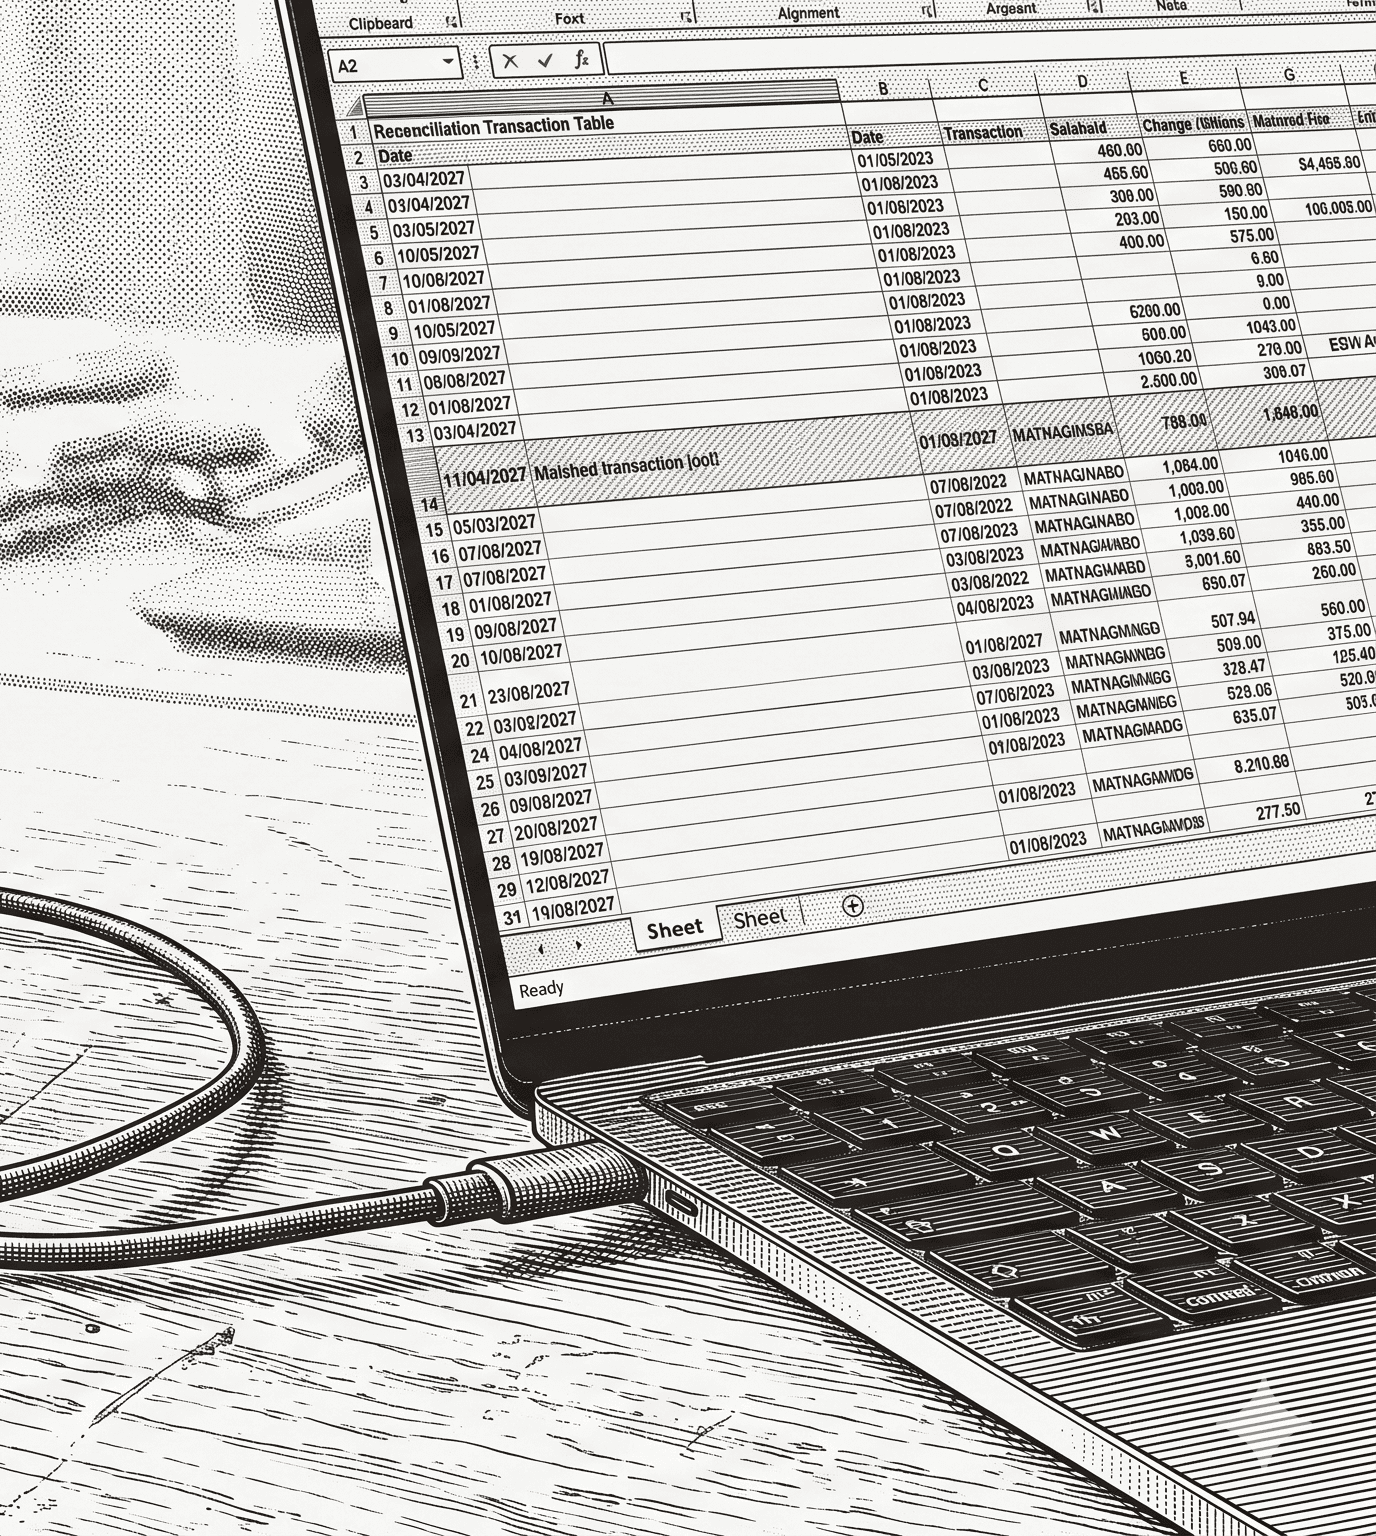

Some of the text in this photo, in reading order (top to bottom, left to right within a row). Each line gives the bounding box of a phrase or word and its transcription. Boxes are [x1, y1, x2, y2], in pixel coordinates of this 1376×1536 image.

[339, 59, 357, 73] A2
[1078, 75, 1087, 87] D
[1179, 71, 1188, 84] E
[1284, 68, 1295, 81] G
[879, 82, 888, 95] B
[979, 79, 988, 91] C
[603, 92, 614, 105] A
[350, 125, 356, 139] 1
[483, 119, 570, 134] Transaction
[573, 115, 614, 130] Table
[943, 125, 1023, 140] Transaction
[1143, 119, 1192, 134] Change
[852, 131, 883, 144] Date
[354, 151, 363, 164] 2
[378, 149, 412, 163] Date
[858, 151, 933, 167] 01/05/2023
[360, 176, 368, 189] 3
[384, 171, 464, 187] 03/04/2027
[862, 175, 938, 191] 01/08/2023
[365, 200, 373, 214] 4
[388, 195, 469, 213] 03/04/2027
[868, 199, 944, 215] 01/08/2023
[1115, 211, 1159, 226] 203.00
[1225, 206, 1267, 220] 150.00
[370, 226, 378, 239] 5
[393, 221, 474, 238] 03/05/2027
[873, 222, 949, 239] 01/08/2023
[1230, 228, 1274, 243] 575.00
[1120, 234, 1164, 248] 400.00
[375, 251, 383, 265] 6
[398, 246, 479, 263] 10/05/2027
[878, 245, 955, 262] 01/08/2023
[379, 276, 386, 290] 7
[1257, 273, 1284, 287] 9.00
[384, 301, 393, 315] 8
[408, 296, 490, 314] 01/08/2027
[1263, 296, 1290, 310] 0.00
[389, 327, 398, 340] 9
[415, 320, 494, 338] 10/05/2027
[1247, 319, 1295, 333] 1043.00
[392, 352, 408, 366] 10
[397, 377, 412, 391] 11
[1141, 372, 1197, 388] 2.500.00
[402, 403, 419, 417] 12
[429, 396, 510, 415] 01/08/2027
[407, 428, 424, 442] 13
[434, 421, 515, 440] 03/04/2027
[444, 457, 684, 487] 11/04/2027 transaction
[421, 497, 438, 512] 14
[1297, 493, 1339, 508] 440.00
[426, 523, 443, 537] 15
[453, 514, 535, 534] 05/03/2027
[1301, 516, 1345, 532] 355.00
[432, 549, 449, 563] 16
[459, 540, 541, 561] 07/08/2027
[947, 547, 1023, 567] 03/08/2023
[464, 566, 545, 587] 07/08/2027
[1312, 563, 1356, 579] 260.00
[436, 575, 452, 590] 17
[952, 571, 1029, 591] 03/08/2022
[442, 601, 460, 616] 18
[470, 591, 551, 613] 01/08/2027
[957, 595, 1034, 616] 04/08/2023
[1321, 599, 1365, 616] 560.00
[1212, 611, 1255, 628] 507.94
[447, 627, 464, 642] 19
[475, 618, 556, 639] 09/08/2027
[1328, 623, 1371, 640] 375.00
[966, 633, 1042, 654] 01/08/2027
[1217, 635, 1261, 652] 509.00
[451, 653, 469, 668] 20
[481, 643, 562, 665] 10/08/2027
[973, 659, 1049, 680] 03/08/2023
[460, 693, 476, 708] 21
[488, 681, 569, 704] 23/08/2027
[977, 683, 1054, 705] 07/08/2023
[982, 707, 1059, 729] 01/08/2023
[1233, 706, 1276, 724] 635.07
[466, 721, 484, 736] 22
[471, 748, 489, 763] 24
[500, 737, 581, 760] 04/08/2027
[477, 774, 494, 790] 25
[510, 789, 591, 813] 09/08/2027
[999, 782, 1075, 804] 01/08/2023
[481, 802, 499, 817] 26
[1257, 802, 1300, 820] 277.50
[487, 828, 503, 844] 27
[515, 816, 597, 840] 20/08/2027
[1010, 831, 1086, 854] 01/08/2023
[521, 842, 603, 866] 19/08/2027
[493, 855, 511, 871] 28
[527, 869, 608, 893] 12/08/2027
[498, 882, 516, 898] 29
[504, 910, 521, 925] 31
[648, 919, 704, 939] Sheet
[520, 980, 563, 998] Ready
[1088, 1126, 1121, 1142] W
[1299, 1145, 1324, 1160] D
[1197, 1161, 1223, 1177] S
[1101, 1179, 1127, 1195] A
